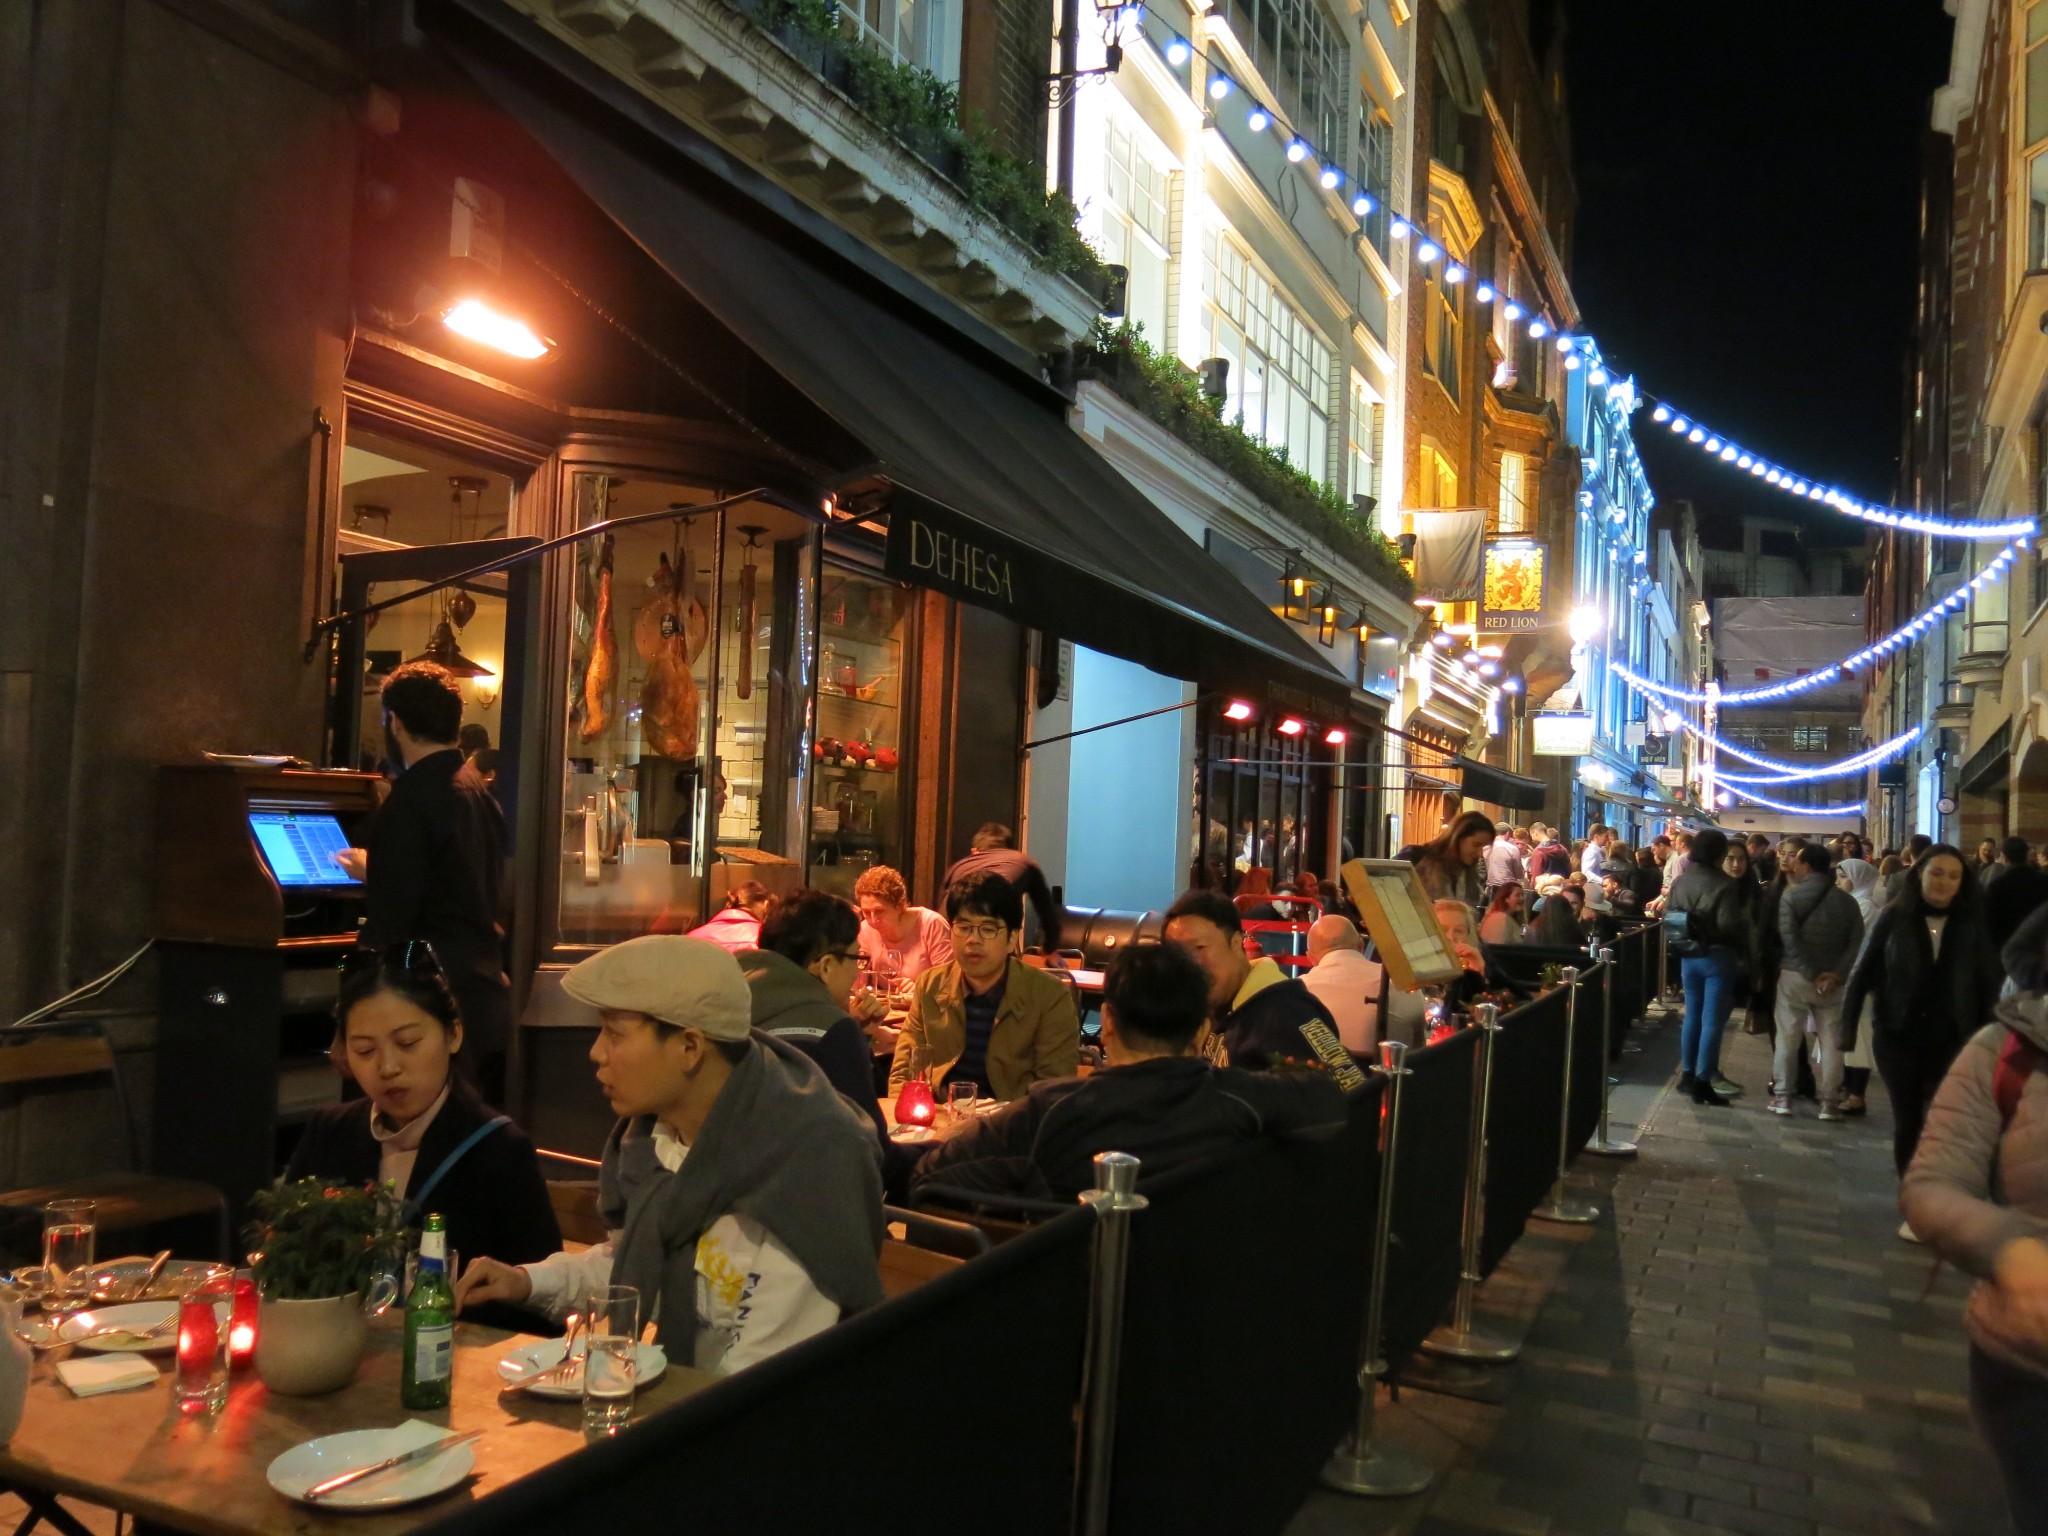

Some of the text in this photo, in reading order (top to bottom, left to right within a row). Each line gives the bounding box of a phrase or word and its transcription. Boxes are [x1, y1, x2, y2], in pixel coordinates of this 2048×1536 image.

[910, 520, 1013, 604] DEHESA
[1484, 617, 1539, 628] RED LION
[1299, 1018, 1352, 1068] YELLOW
